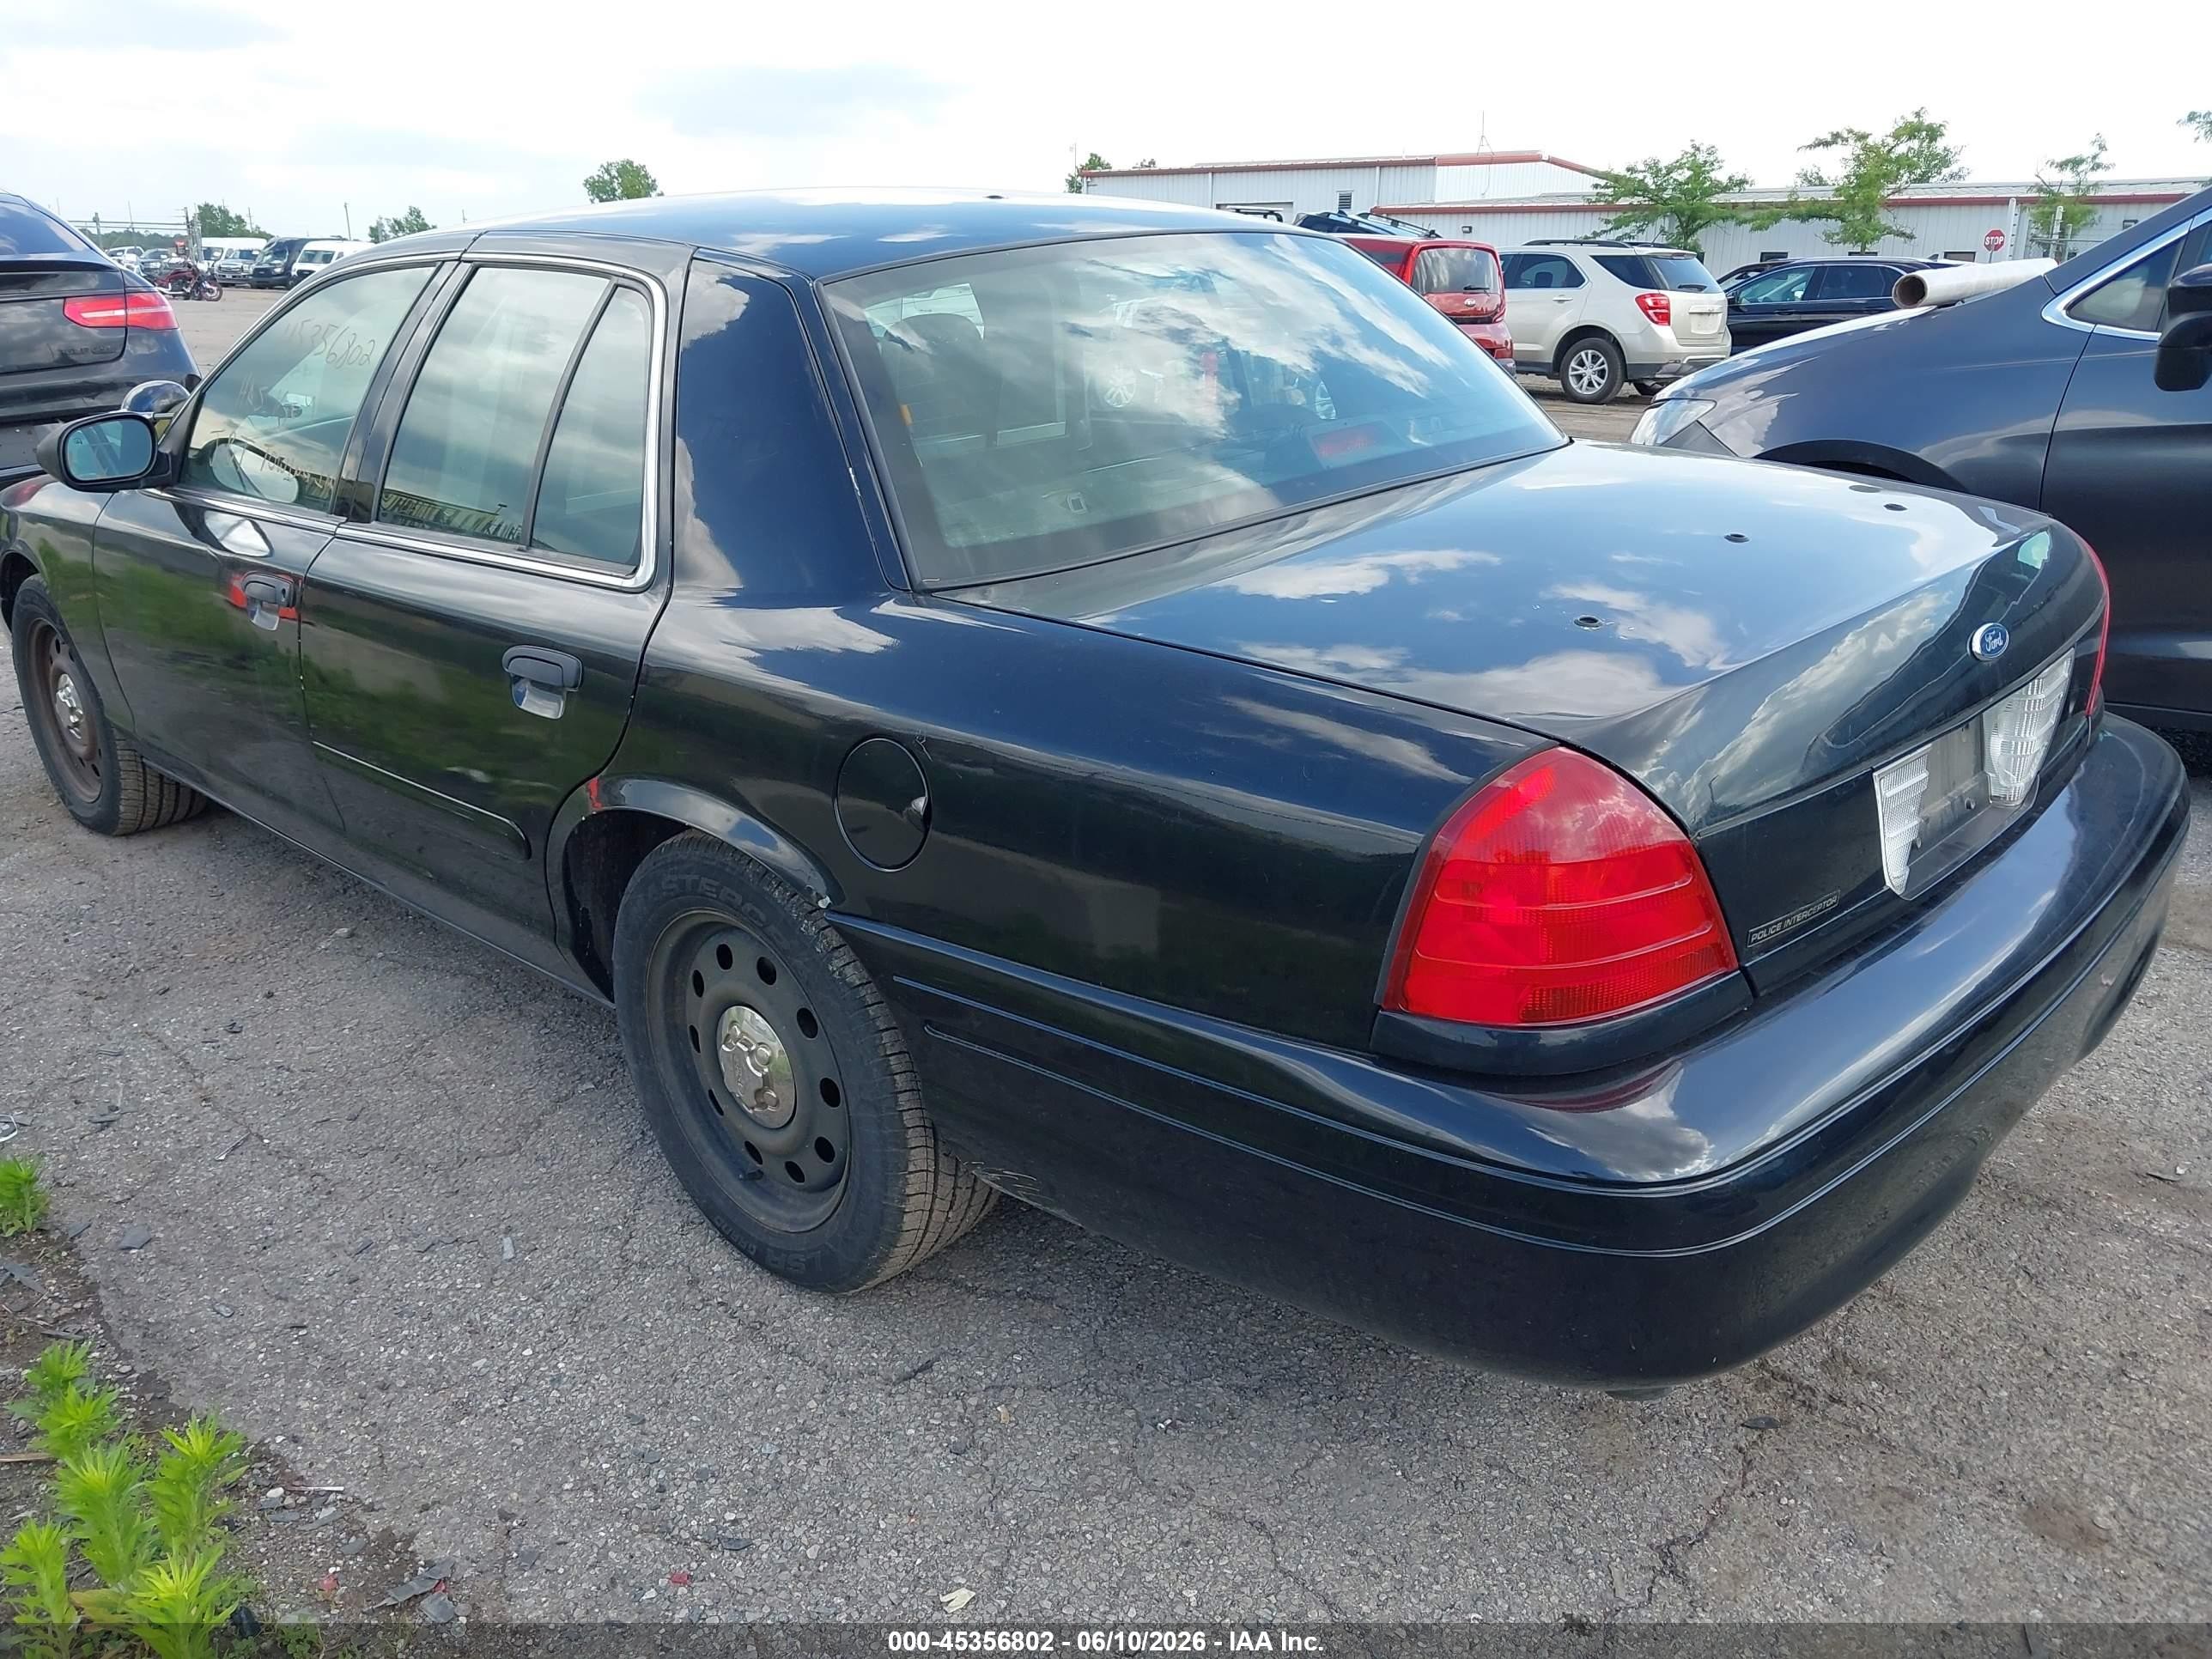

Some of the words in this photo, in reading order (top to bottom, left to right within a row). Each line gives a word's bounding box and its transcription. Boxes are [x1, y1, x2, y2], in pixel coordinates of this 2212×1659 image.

[1984, 235, 2004, 246] STOP
[1984, 629, 2003, 652] Ford
[1751, 921, 1783, 944] POLICE
[1784, 895, 1838, 928] INTERCEPTOR
